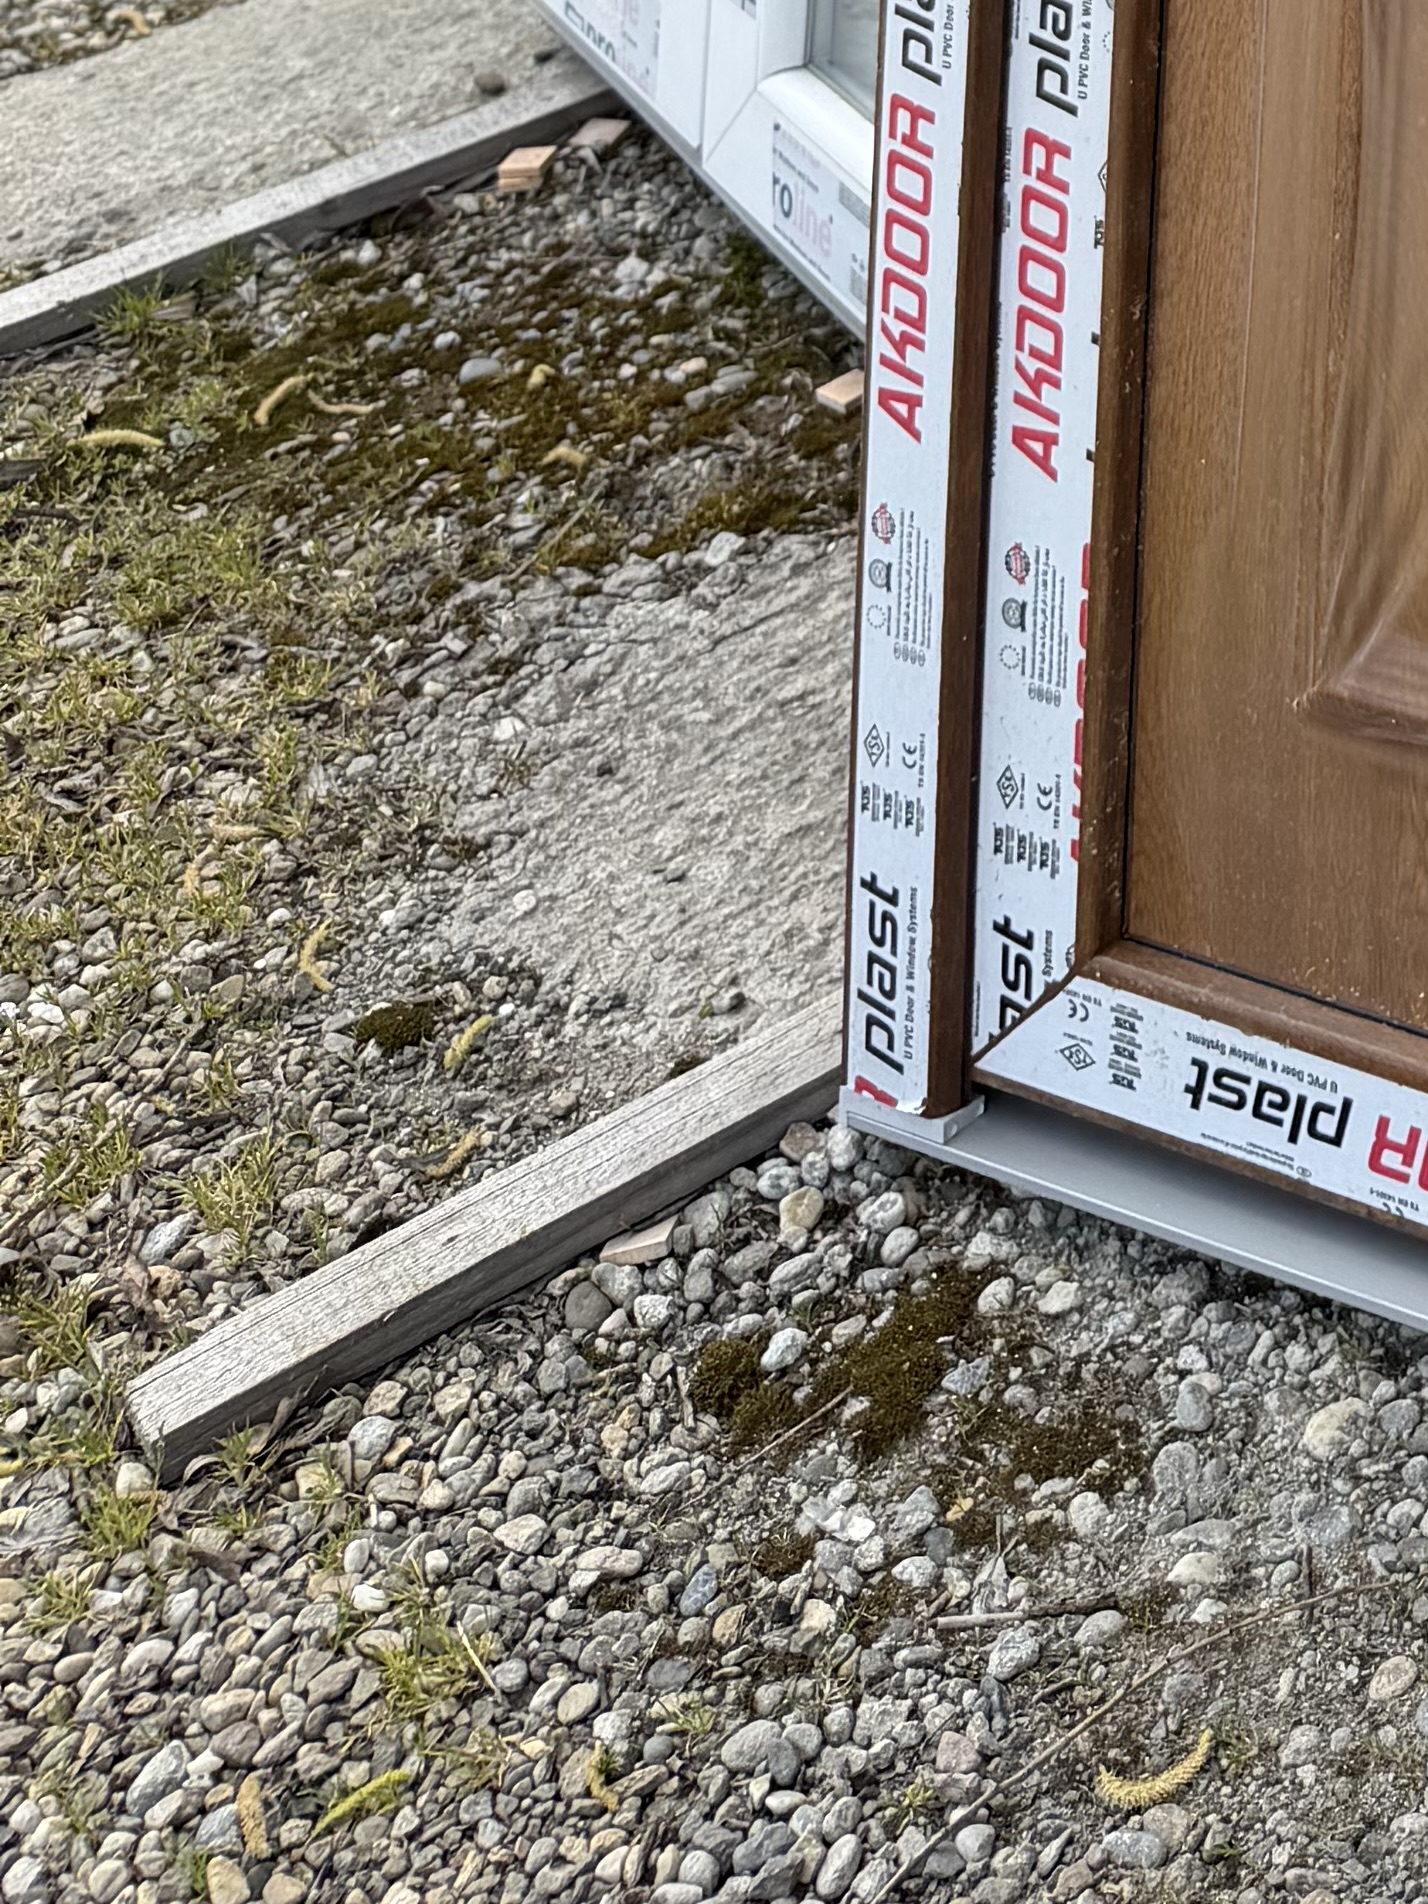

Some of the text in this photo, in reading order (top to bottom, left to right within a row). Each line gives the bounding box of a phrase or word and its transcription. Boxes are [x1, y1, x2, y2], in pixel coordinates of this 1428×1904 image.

[877, 93, 935, 443] AKDOOR
[1011, 127, 1071, 482] AKDOOR
[857, 872, 904, 1075] plast
[1183, 1056, 1353, 1148] plast
